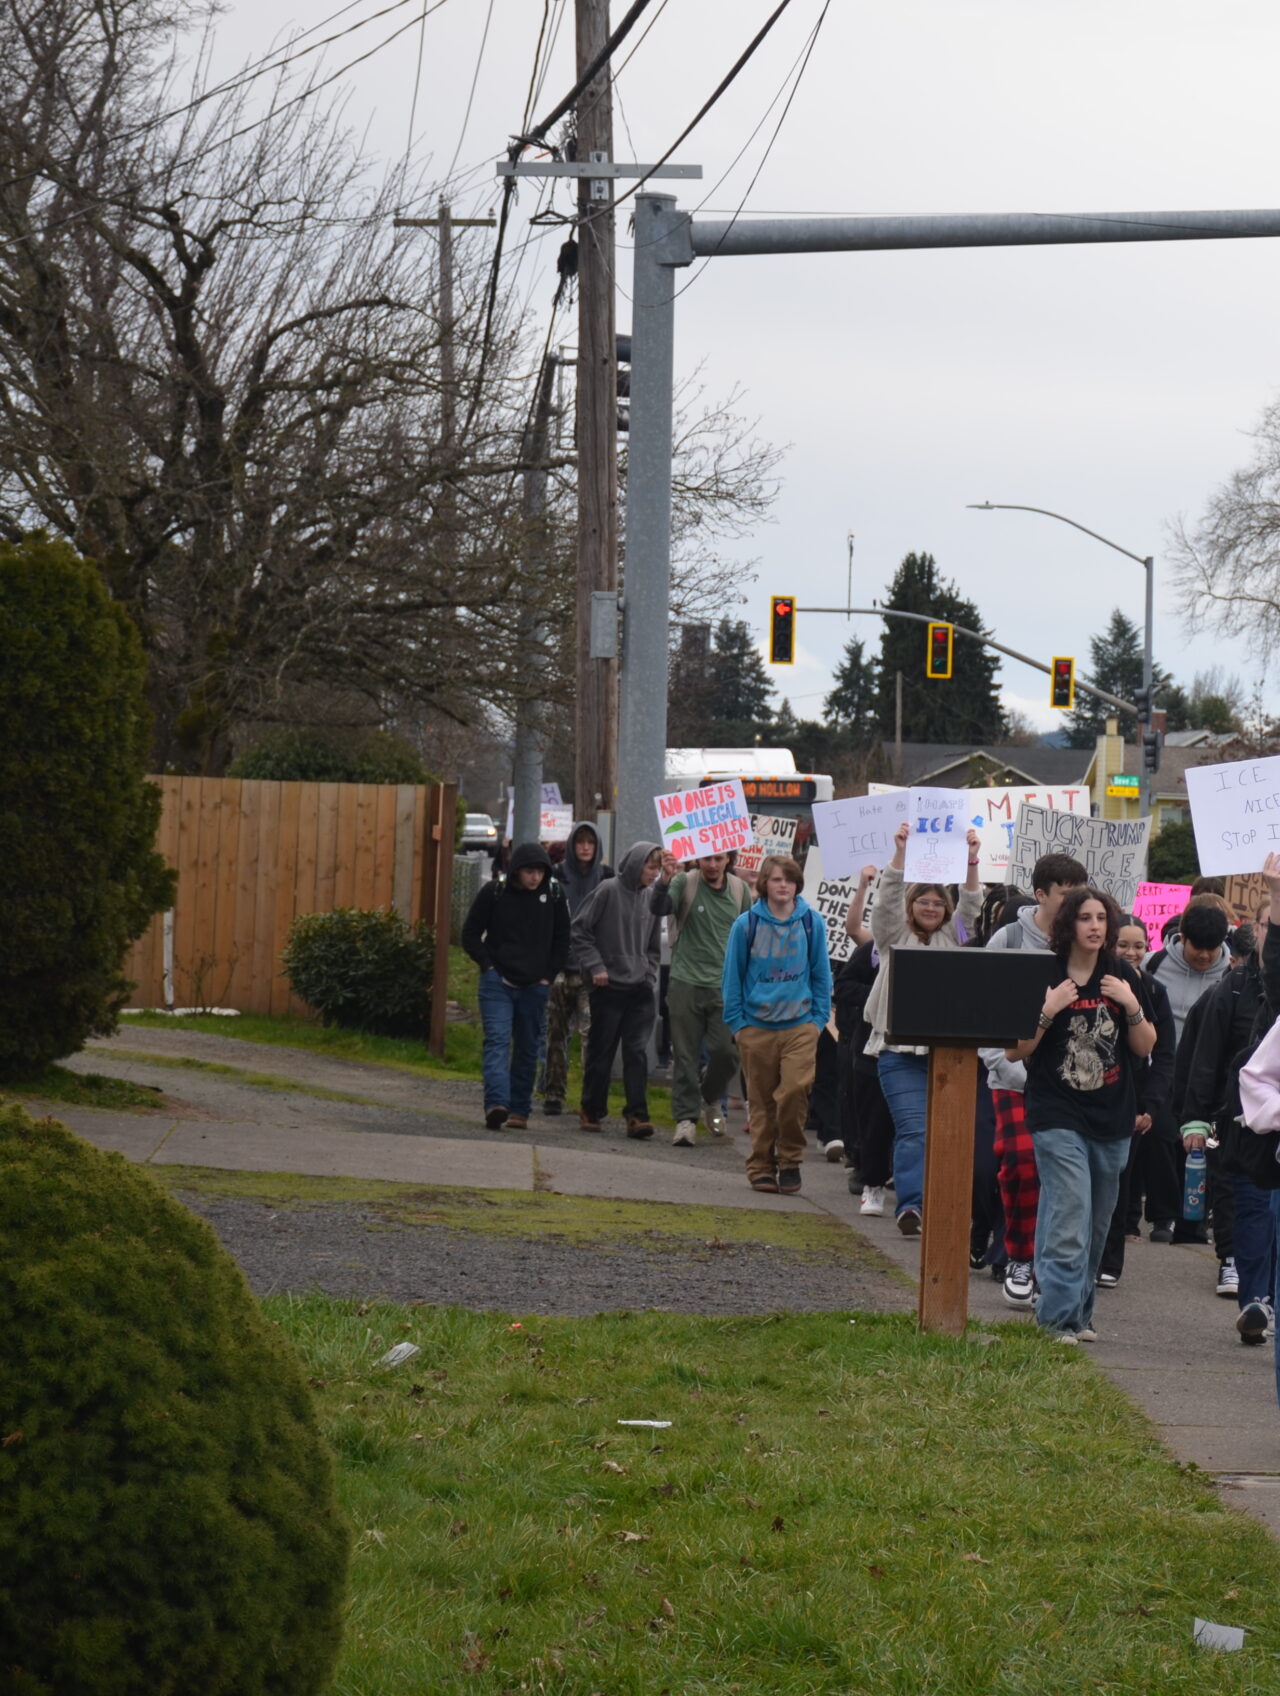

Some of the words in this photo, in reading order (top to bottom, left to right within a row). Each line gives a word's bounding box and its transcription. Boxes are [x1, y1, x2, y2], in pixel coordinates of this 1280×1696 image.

[759, 783, 801, 797] HOLLOW
[659, 795, 682, 819] NO
[685, 788, 717, 813] ONE
[719, 784, 736, 803] IS
[686, 801, 742, 829] ILLEGAL
[916, 814, 955, 833] ICE
[772, 818, 797, 839] OUT
[1020, 803, 1085, 847] FUCK
[1086, 819, 1146, 849] TRUMP
[671, 835, 695, 860] ON
[712, 834, 746, 853] LAND
[1221, 829, 1257, 850] STOP
